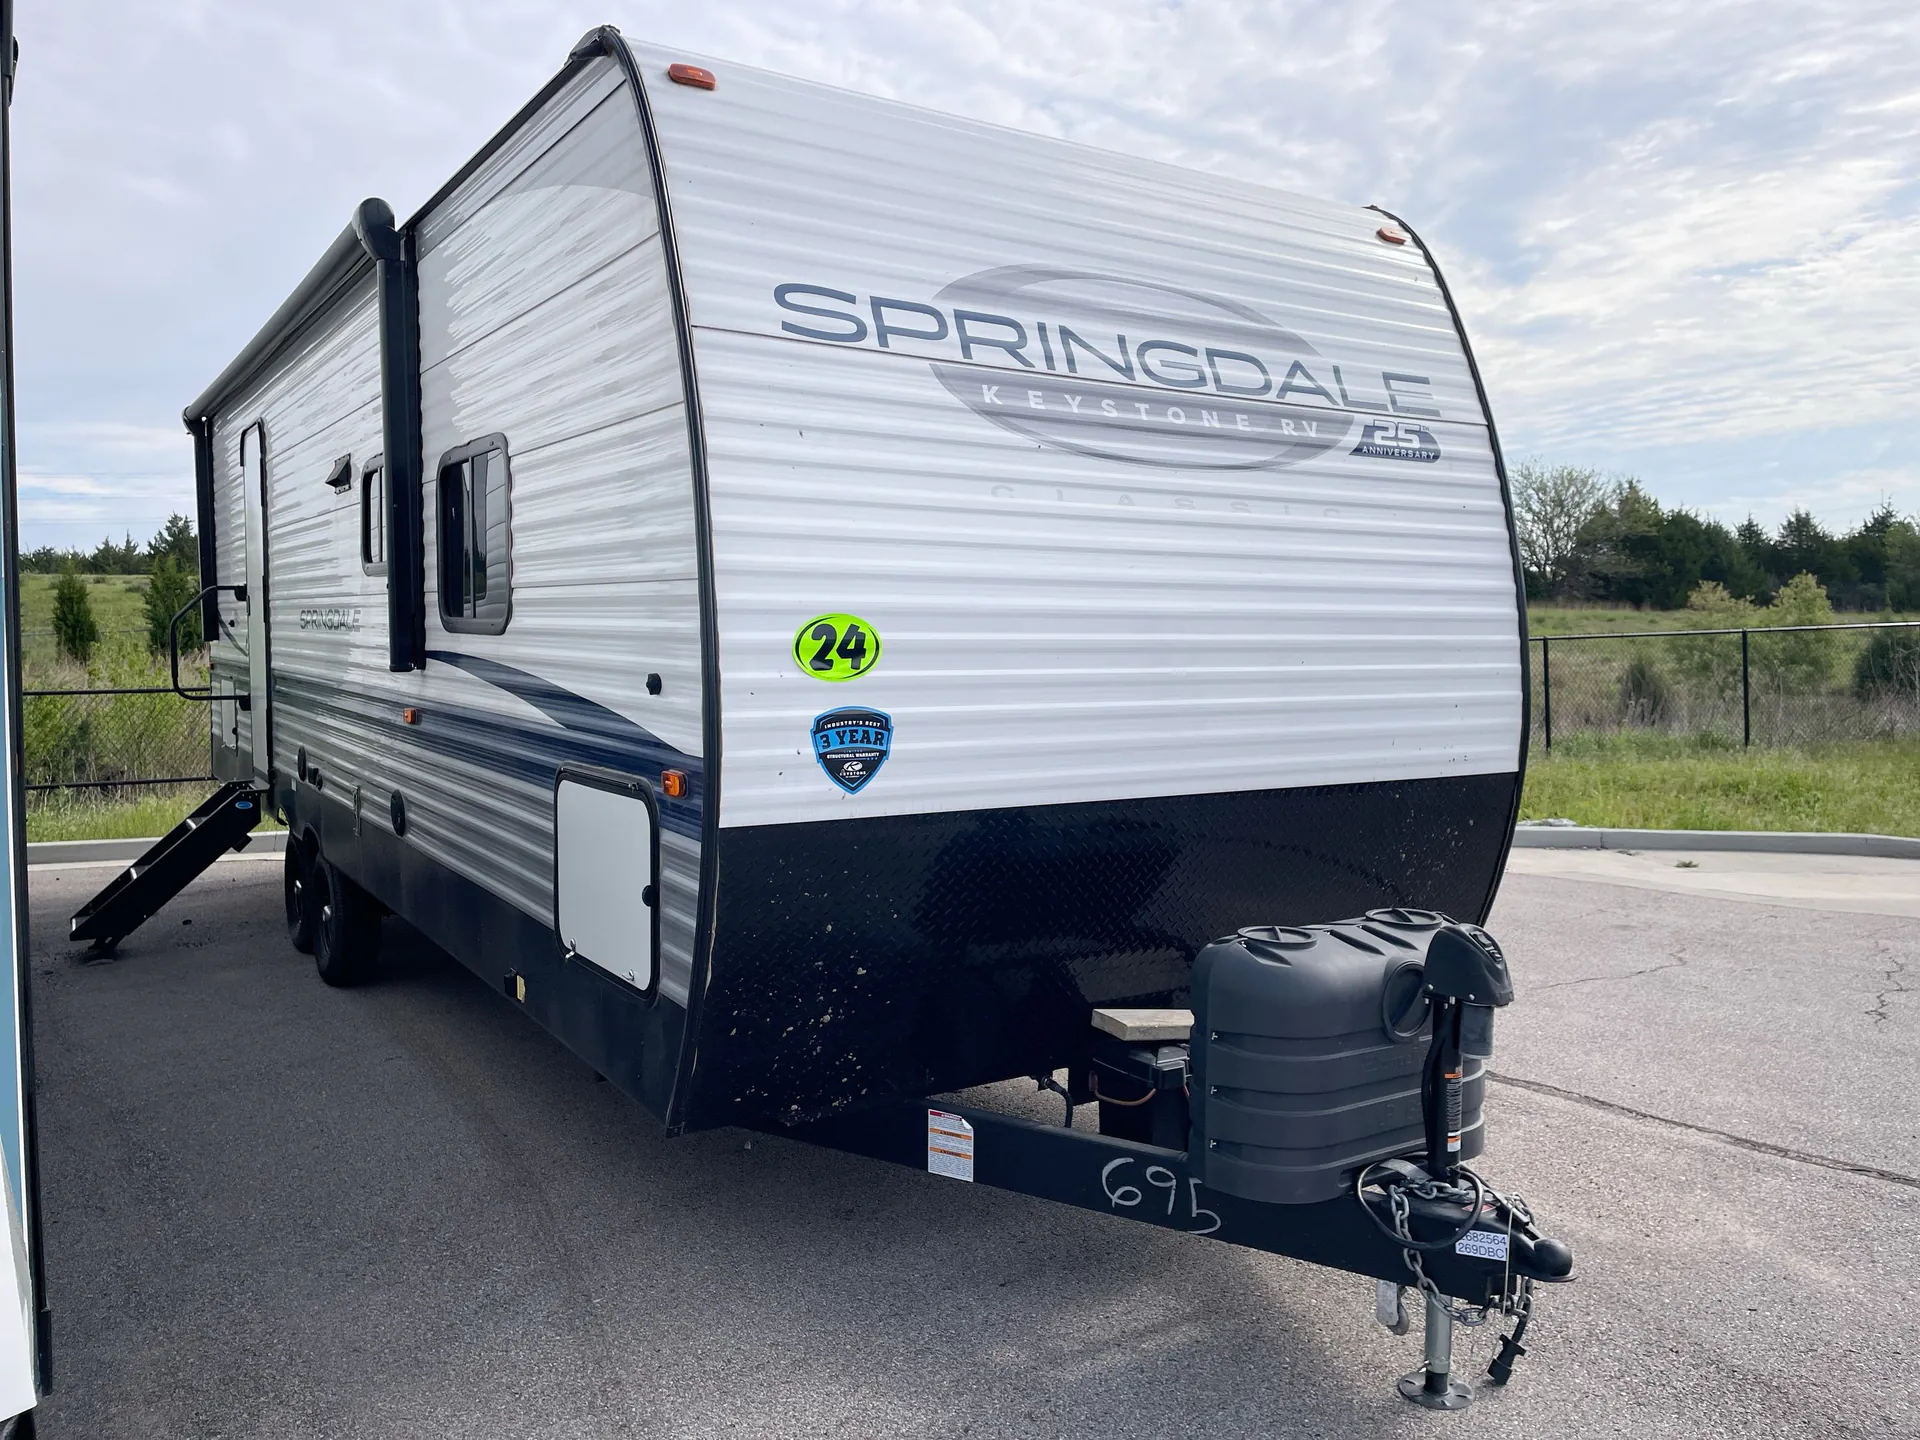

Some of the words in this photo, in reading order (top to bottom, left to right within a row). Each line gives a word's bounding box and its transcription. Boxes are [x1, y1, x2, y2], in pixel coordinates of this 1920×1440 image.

[774, 282, 1441, 418] SPRINGDALE
[981, 384, 1251, 431] KEYSTONE
[1281, 418, 1318, 438] RV
[1362, 445, 1435, 460] ANNIVERSARY
[300, 609, 361, 632] SPRINGDALE
[809, 623, 867, 671] 24
[824, 720, 863, 729] INDUSTRY'S
[820, 733, 831, 749] 3
[835, 728, 885, 746] YEAR
[1102, 1157, 1221, 1234] 695
[1461, 1231, 1506, 1245] 682564
[1458, 1242, 1507, 1258] 269DBC
